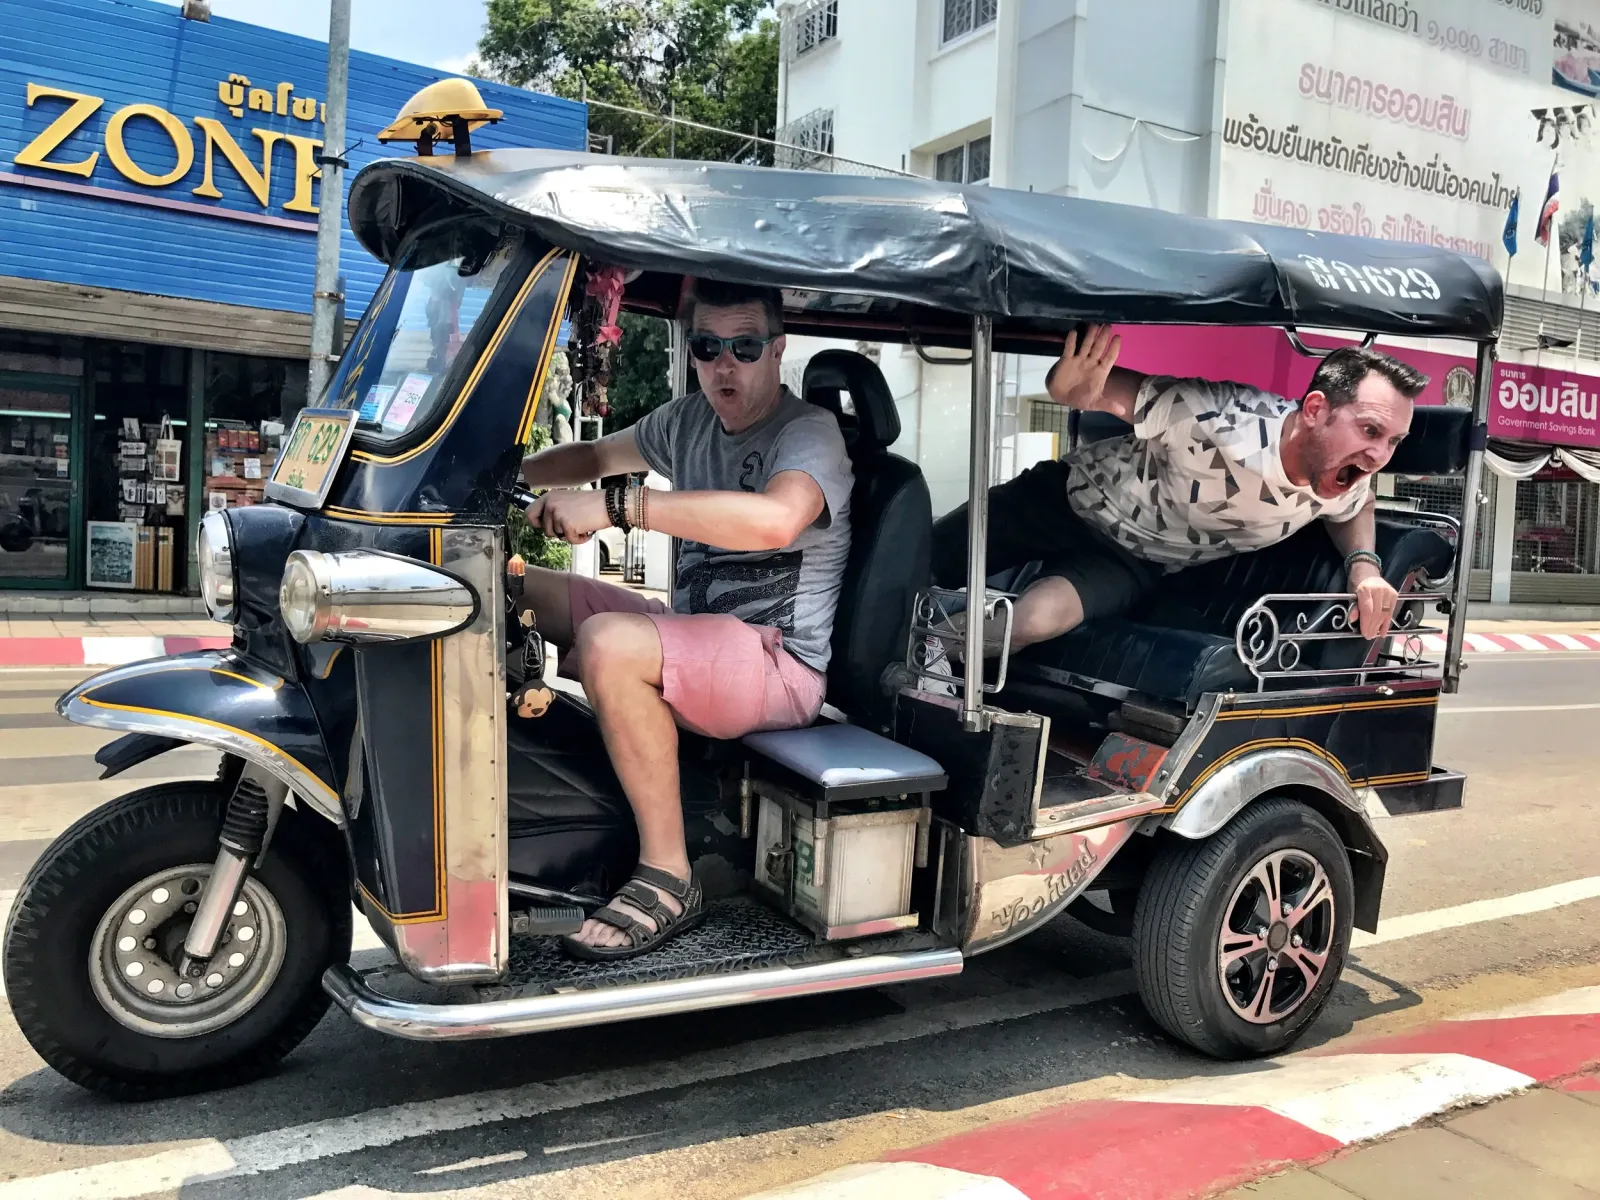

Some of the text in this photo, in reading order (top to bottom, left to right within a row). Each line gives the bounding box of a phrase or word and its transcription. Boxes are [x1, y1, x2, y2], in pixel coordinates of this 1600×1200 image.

[1488, 38, 1528, 69] สาขา
[218, 73, 326, 122] บุ๊คโซ
[1299, 62, 1468, 137] ธนาคารออมสิน
[1498, 380, 1598, 421] ออมสิน
[308, 422, 341, 464] 629
[1497, 415, 1596, 437] Government Savings Bank
